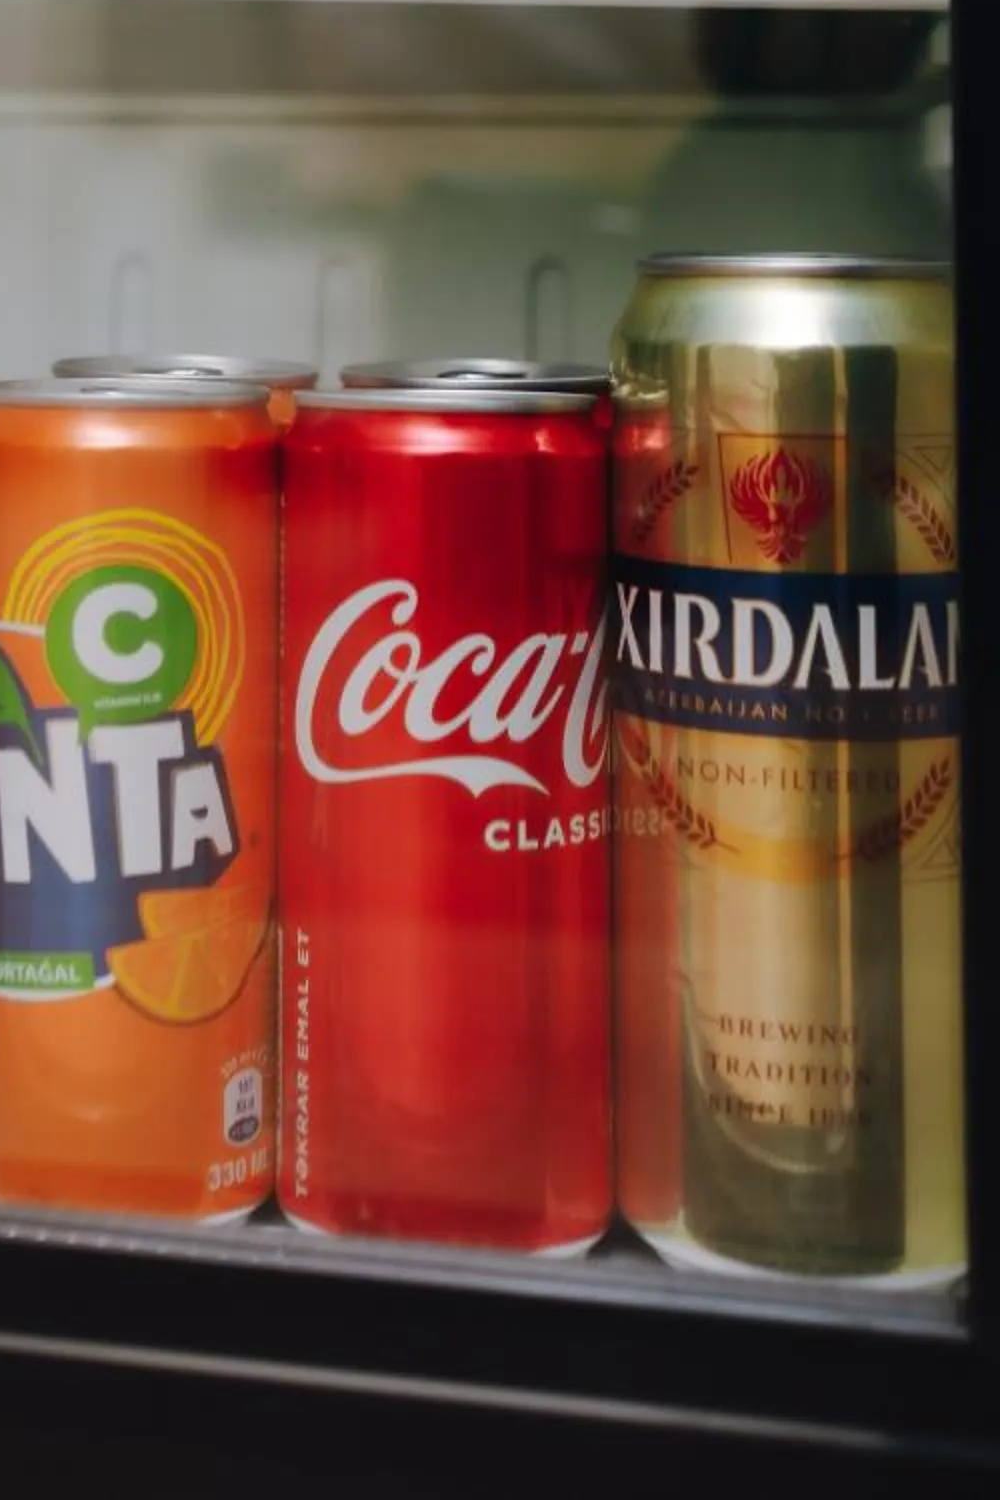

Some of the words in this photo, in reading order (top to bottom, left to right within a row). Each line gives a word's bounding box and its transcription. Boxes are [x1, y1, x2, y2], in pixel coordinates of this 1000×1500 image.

[71, 581, 165, 685] C
[295, 578, 612, 798] Coca-C
[645, 690, 788, 722] AZERBAIJAN
[297, 929, 310, 967] ET
[296, 979, 310, 1060] EMAL
[719, 1014, 860, 1047] BREWING
[707, 1051, 871, 1087] TRADITION
[207, 1156, 247, 1191] 330
